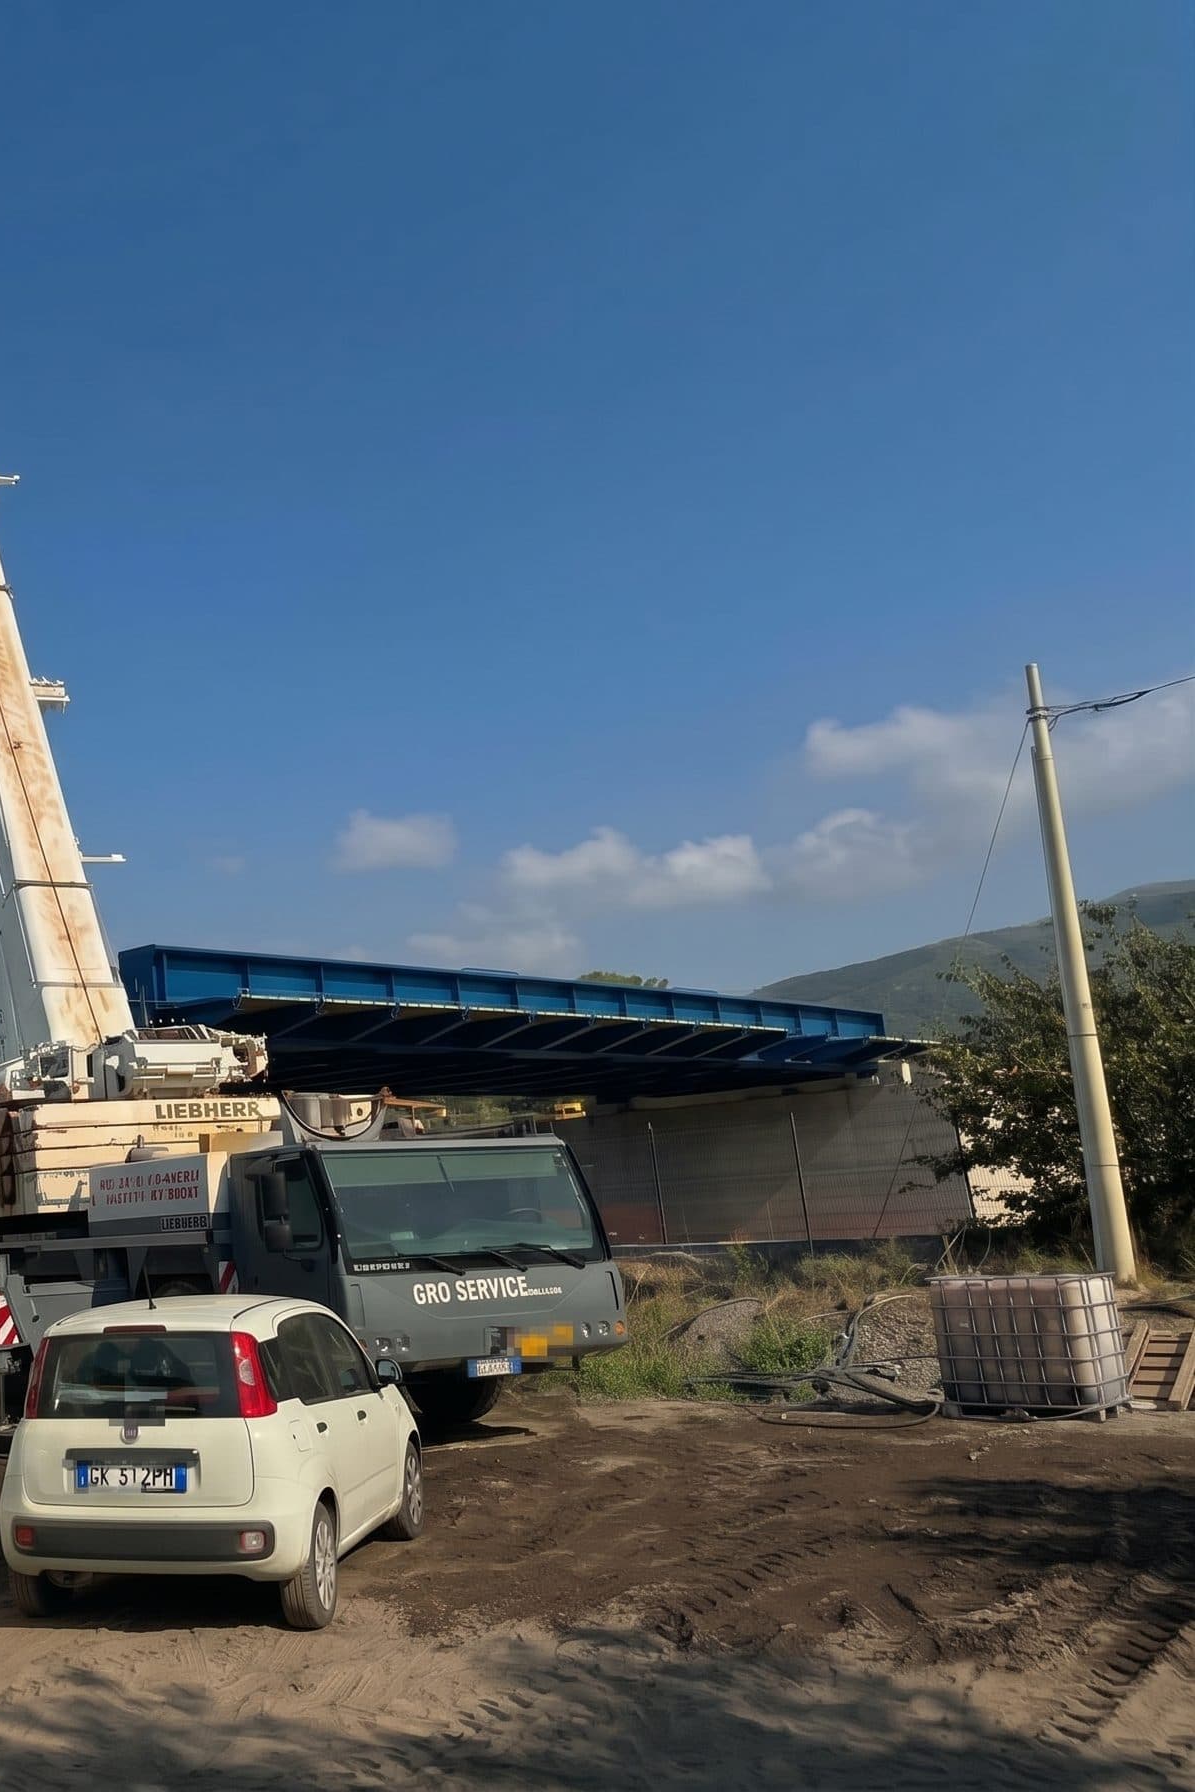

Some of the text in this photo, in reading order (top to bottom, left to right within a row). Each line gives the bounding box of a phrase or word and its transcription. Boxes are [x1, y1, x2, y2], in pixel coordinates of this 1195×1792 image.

[155, 1101, 261, 1120] LIEBHERR
[413, 1276, 528, 1305] GRO SERVICE
